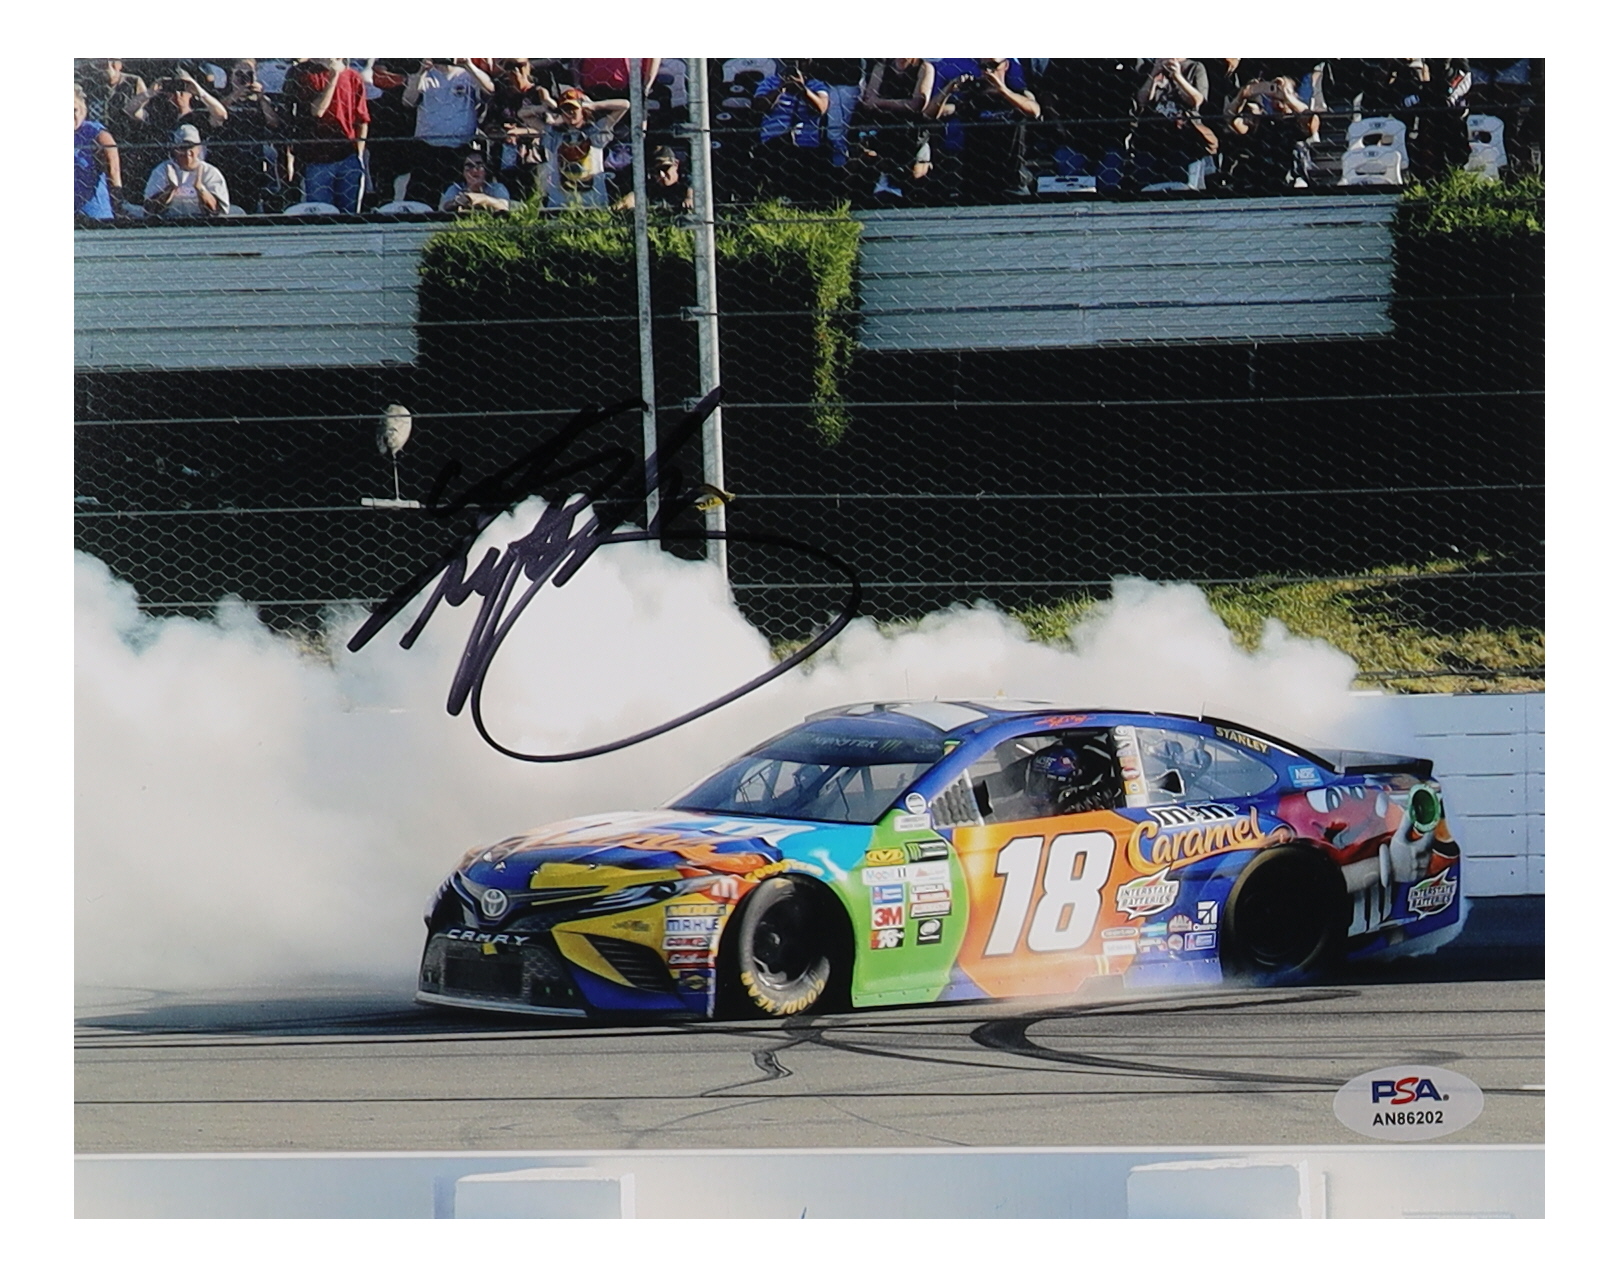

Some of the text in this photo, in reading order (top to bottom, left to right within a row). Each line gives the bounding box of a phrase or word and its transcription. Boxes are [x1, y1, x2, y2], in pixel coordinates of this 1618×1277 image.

[1215, 726, 1268, 754] STANLEY
[1128, 805, 1266, 874] Caramel
[984, 830, 1116, 956] 18
[1120, 884, 1173, 897] INTERSTATE
[1121, 894, 1171, 907] BATTERIES
[874, 906, 903, 928] 3M
[446, 928, 530, 946] CAMRY
[1371, 1076, 1443, 1105] PSA
[1373, 1110, 1444, 1126] AN86202
